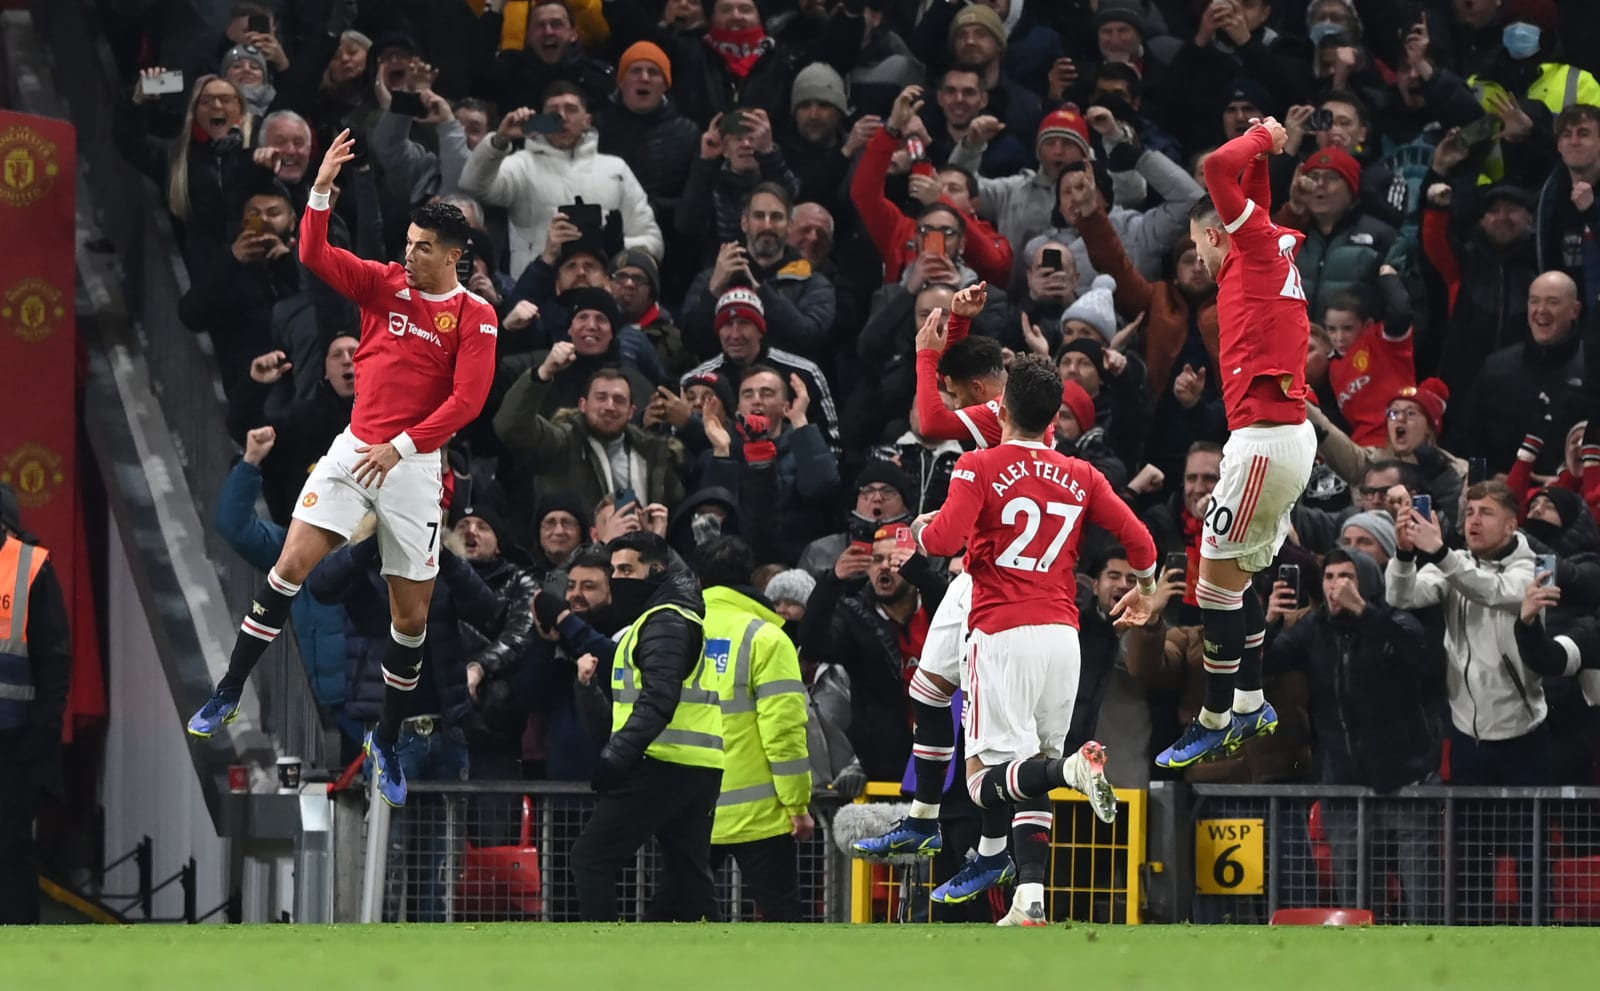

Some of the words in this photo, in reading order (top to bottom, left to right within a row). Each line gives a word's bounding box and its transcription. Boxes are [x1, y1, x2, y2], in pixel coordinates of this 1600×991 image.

[991, 460, 1031, 497] ALEX
[1033, 461, 1087, 502] TELLES
[426, 521, 439, 552] 7
[995, 497, 1083, 573] 27
[1208, 825, 1250, 840] WSP
[1213, 844, 1244, 888] 6
